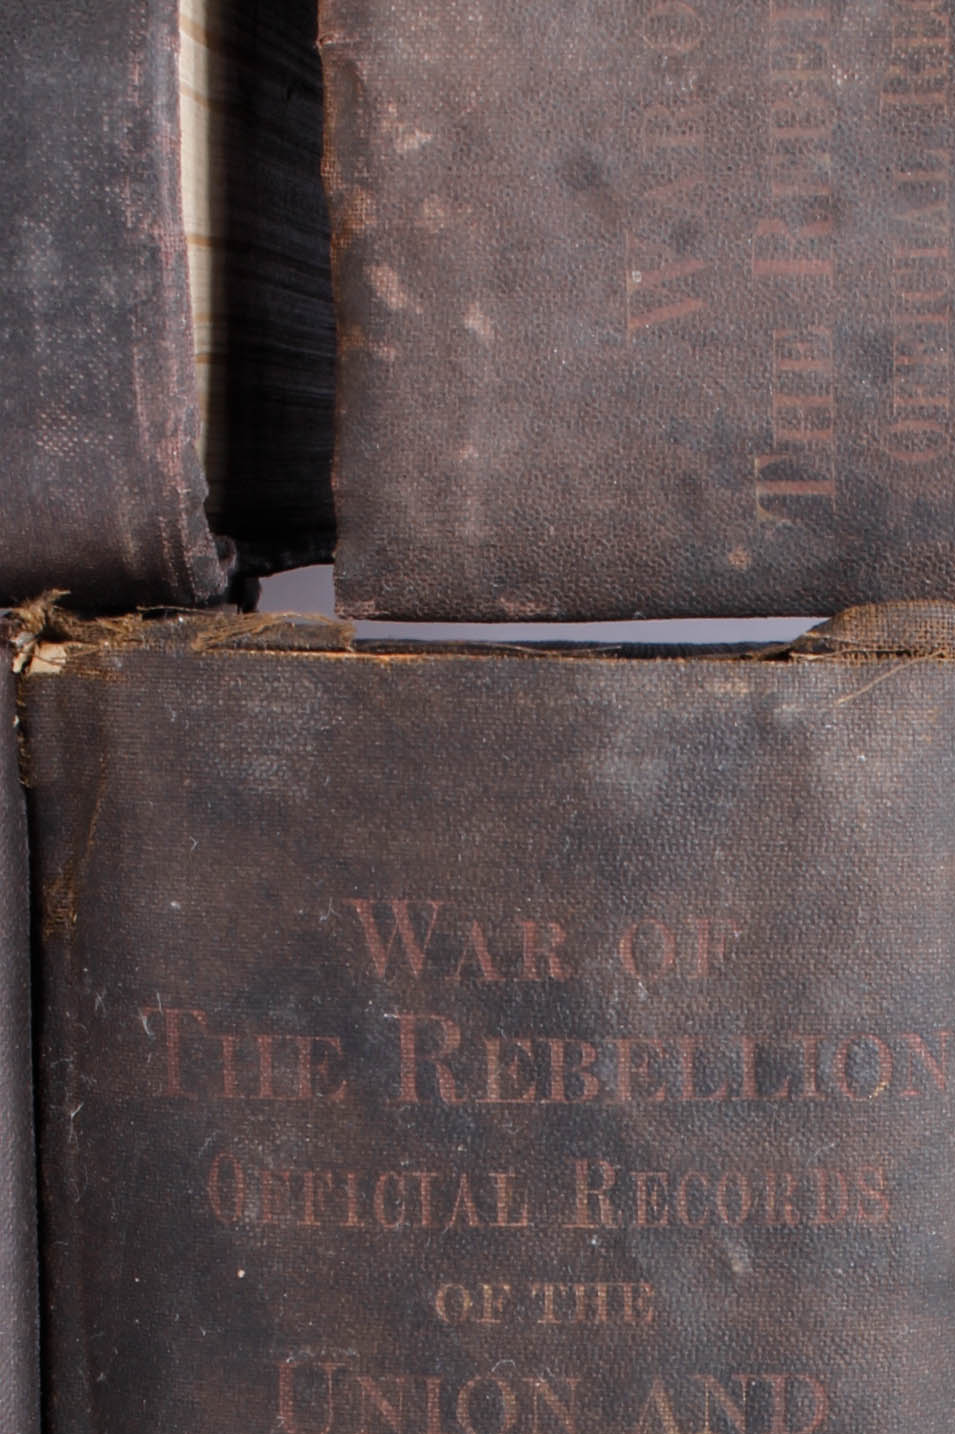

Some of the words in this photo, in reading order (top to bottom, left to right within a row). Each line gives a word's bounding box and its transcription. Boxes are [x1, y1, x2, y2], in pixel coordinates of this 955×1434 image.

[626, 90, 708, 342] WAR
[883, 146, 951, 465] OFFICIAL
[752, 324, 837, 526] THE
[345, 896, 574, 986] WAR
[617, 913, 742, 982] OF
[140, 1002, 352, 1103] THE
[386, 1010, 955, 1107] REBELLION
[205, 1147, 532, 1232] OFFICIAL
[564, 1152, 894, 1232] RECORDS
[432, 1281, 515, 1327] OF
[530, 1280, 659, 1327] THE
